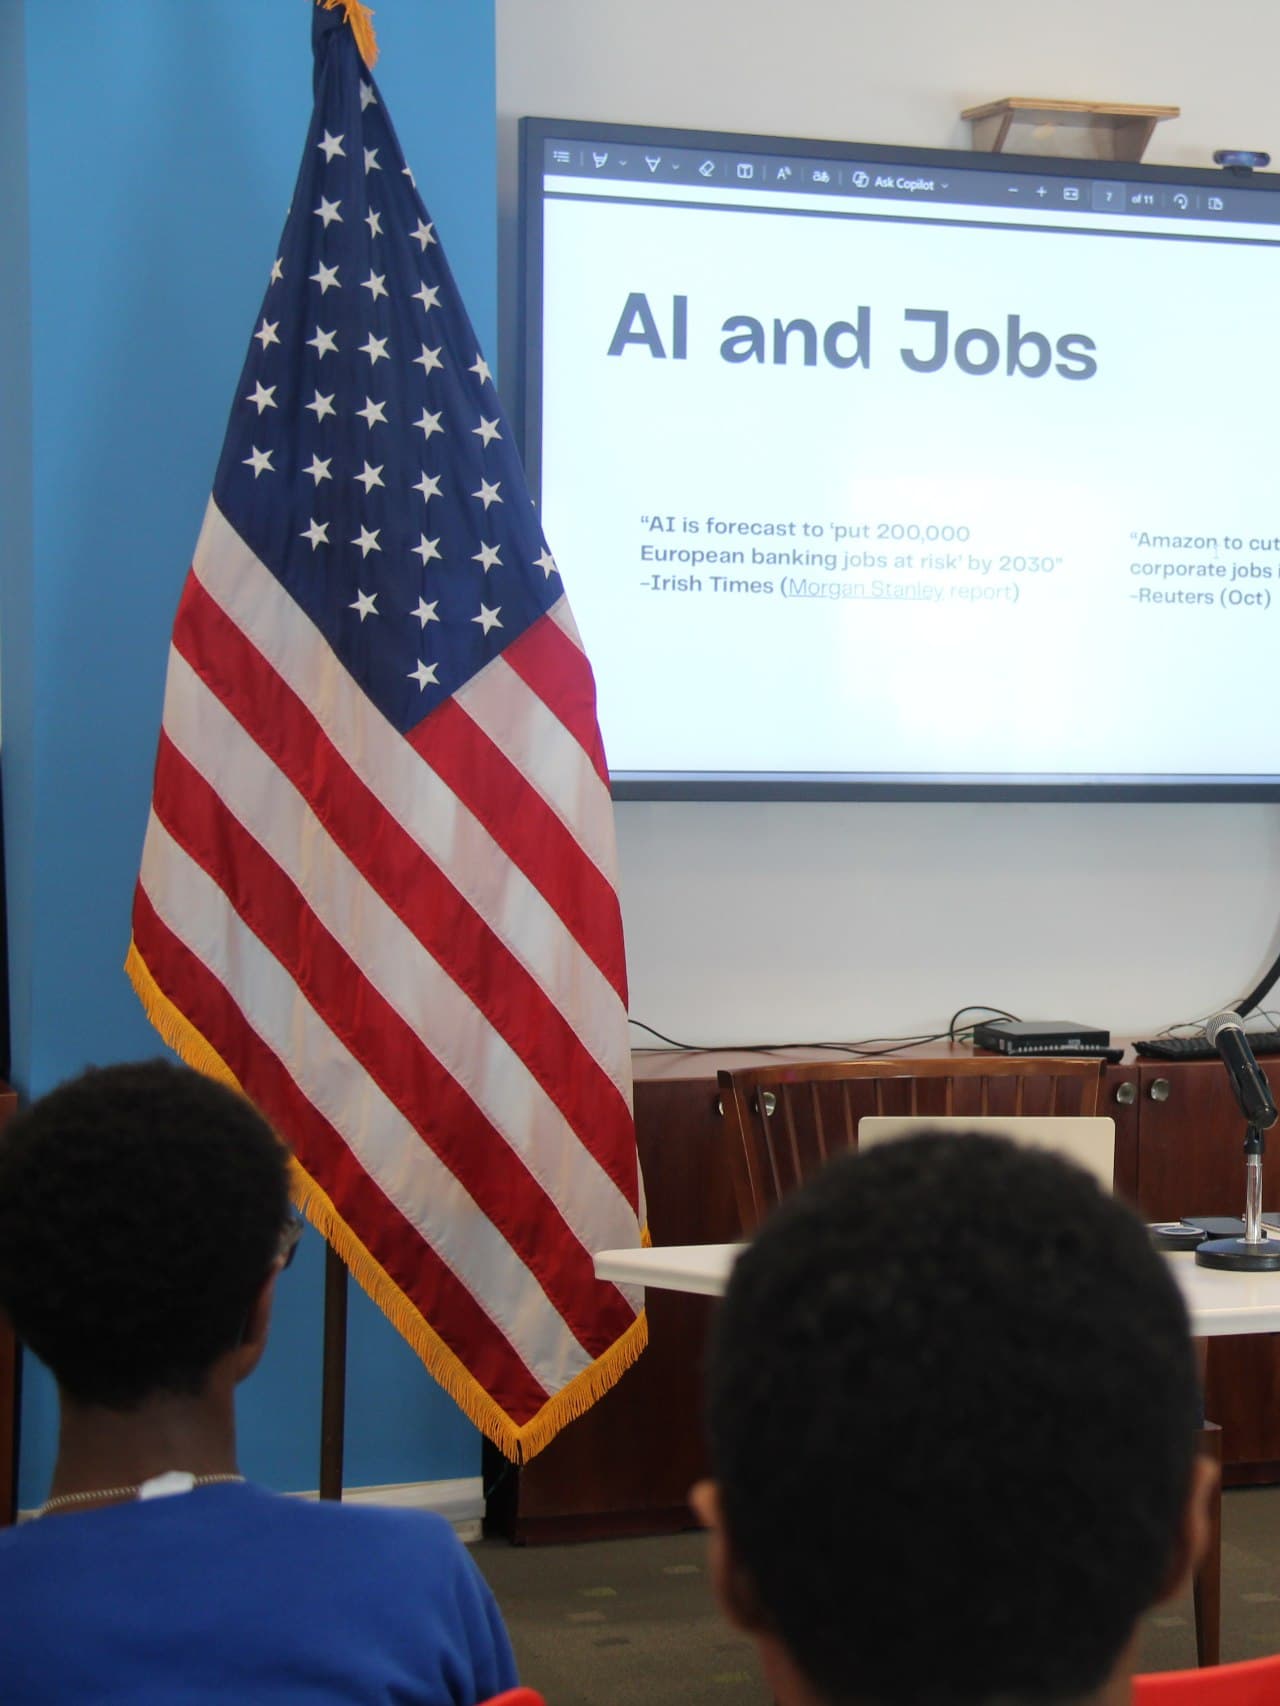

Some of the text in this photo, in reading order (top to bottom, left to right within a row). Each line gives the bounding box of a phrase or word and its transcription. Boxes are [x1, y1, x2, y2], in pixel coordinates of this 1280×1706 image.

[874, 176, 935, 192] Ask Copilot
[1143, 194, 1154, 205] 11
[607, 292, 1098, 381] AI and Jobs
[682, 516, 700, 535] is
[705, 517, 797, 537] forecast
[802, 522, 825, 539] to
[876, 523, 971, 545] 200,000
[1223, 536, 1243, 551] to
[1249, 537, 1280, 552] cut
[640, 544, 745, 567] European
[751, 547, 838, 571] banking
[840, 551, 888, 572] jobs
[893, 553, 914, 569] at
[968, 554, 993, 576] by
[1129, 562, 1228, 581] corporate
[1229, 561, 1273, 582] jobs
[708, 575, 775, 594] Times
[780, 576, 866, 600] (Morgan
[871, 580, 945, 601] Stanley
[950, 583, 1020, 604] report)
[1219, 586, 1272, 610] (Oct)
